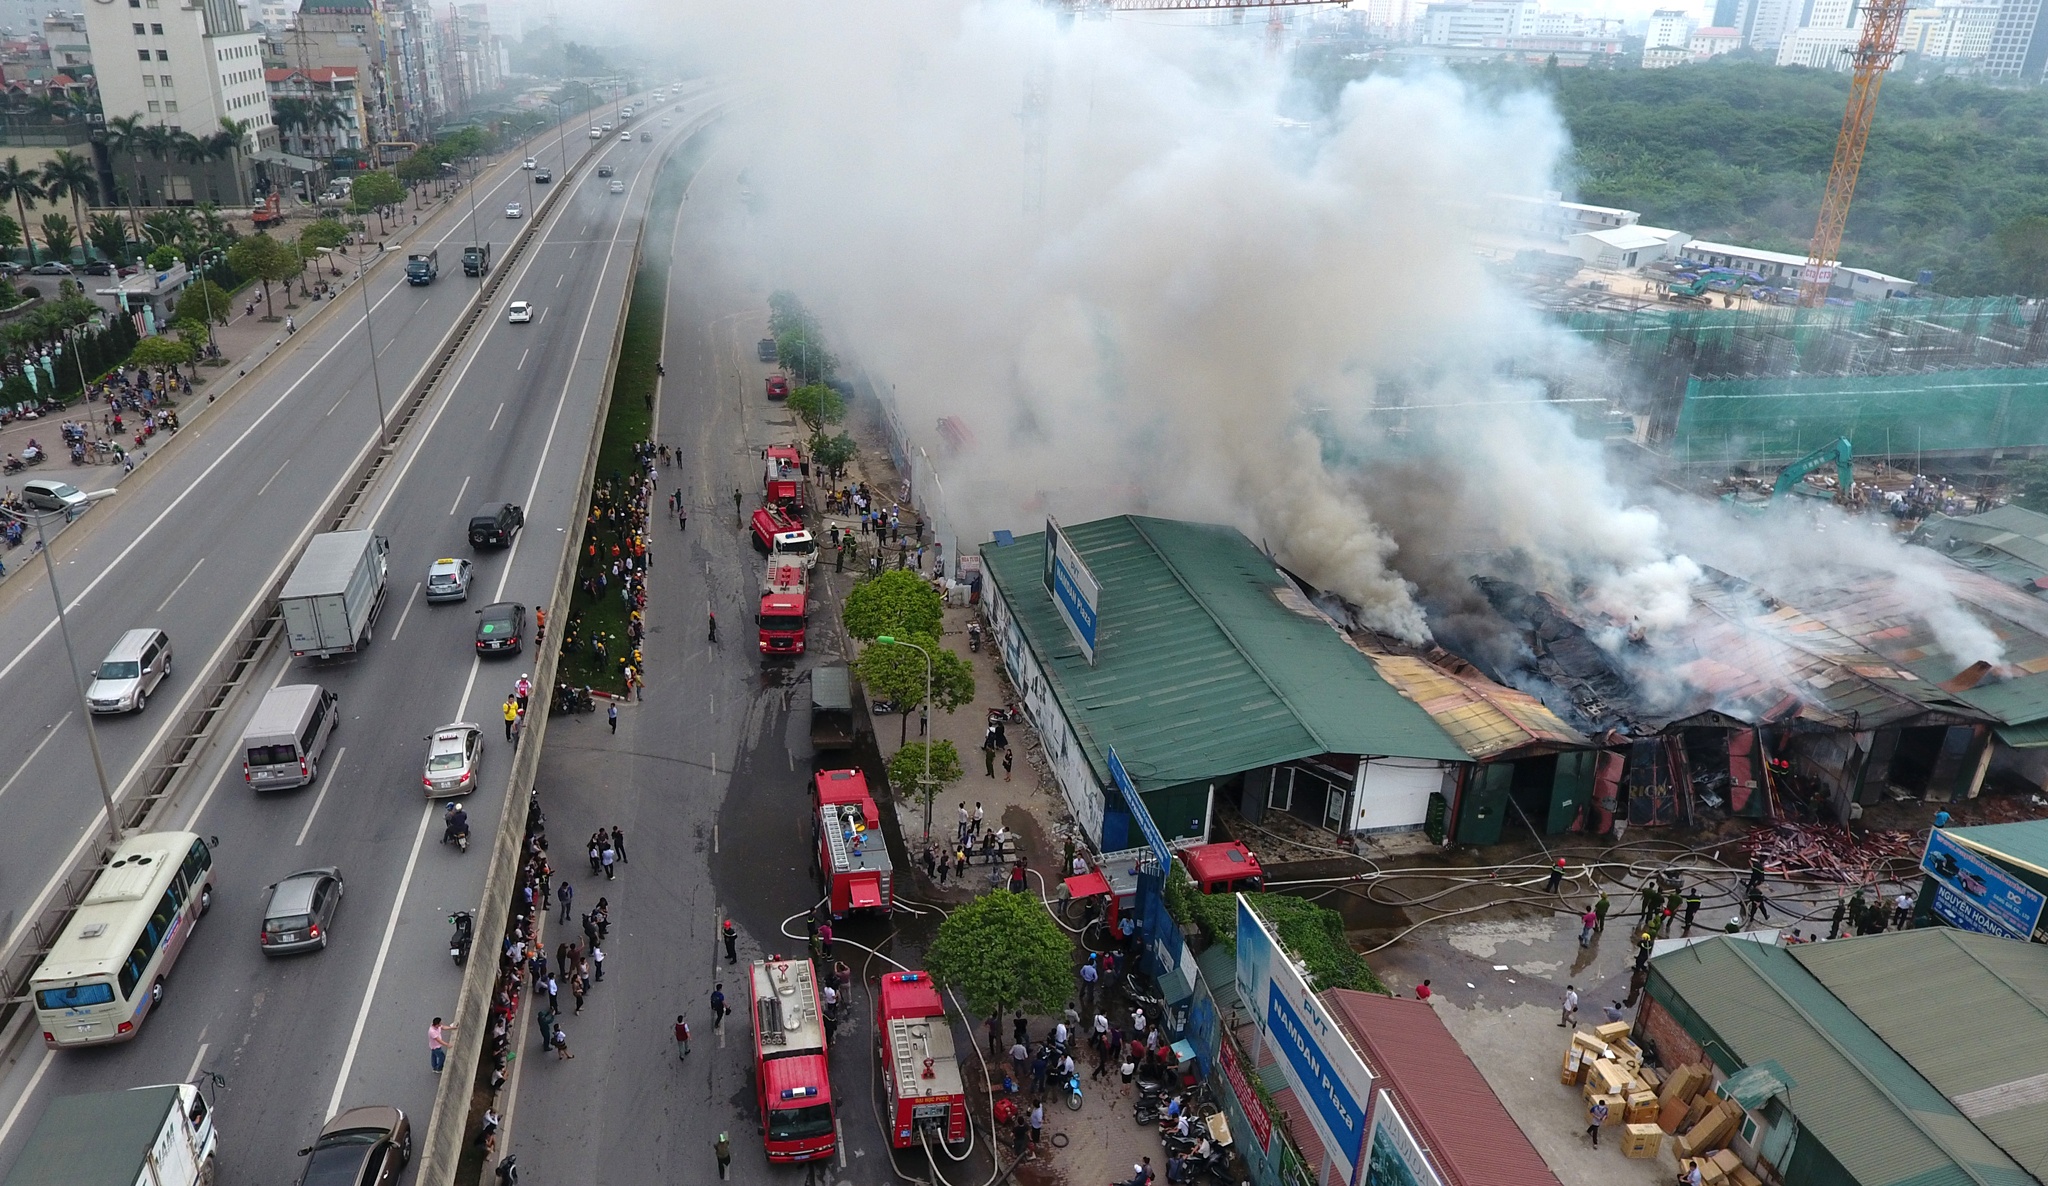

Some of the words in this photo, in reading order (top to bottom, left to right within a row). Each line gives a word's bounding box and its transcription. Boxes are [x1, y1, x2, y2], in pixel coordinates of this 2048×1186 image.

[1304, 998, 1328, 1036] PVT
[1274, 998, 1321, 1078] NAMDAN
[1322, 1074, 1354, 1132] Plaza
